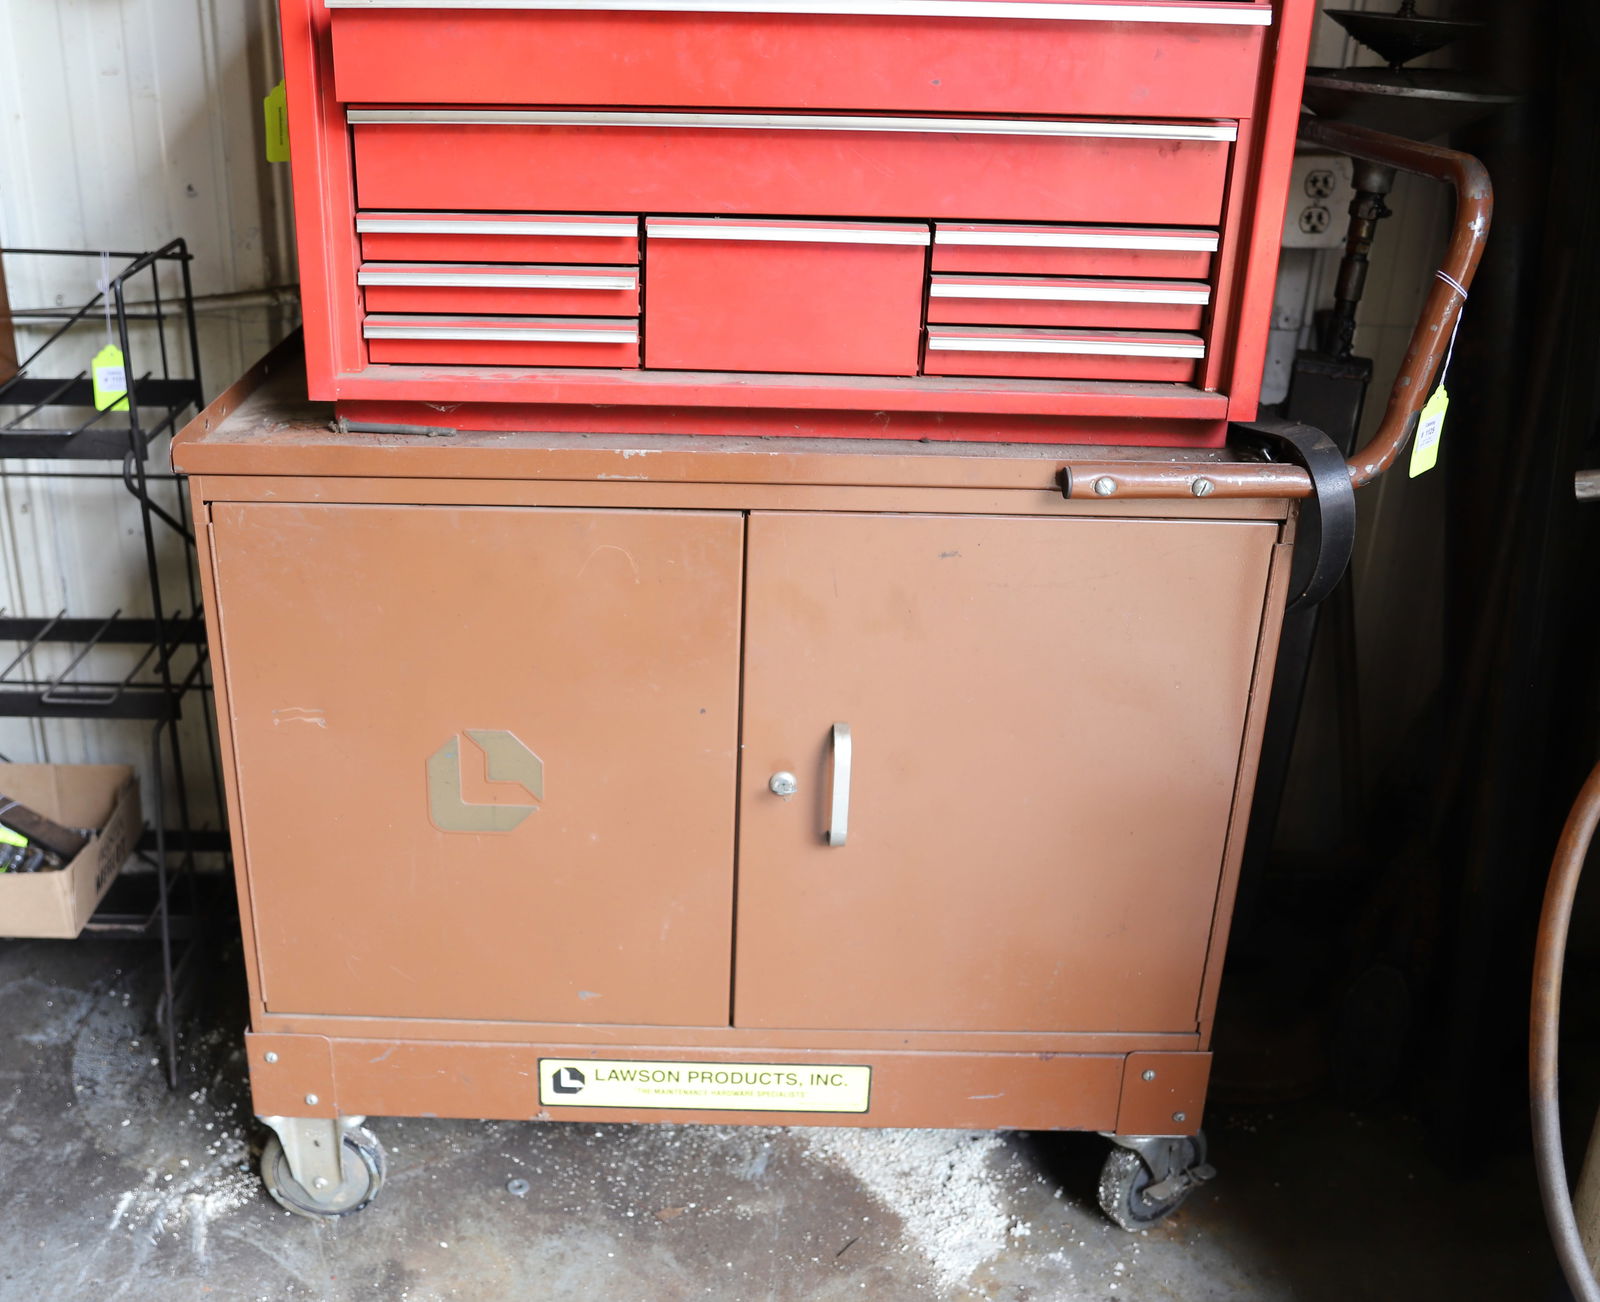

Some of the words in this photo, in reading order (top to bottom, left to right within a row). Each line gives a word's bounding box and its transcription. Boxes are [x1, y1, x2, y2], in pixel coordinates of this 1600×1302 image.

[594, 1068, 680, 1084] LAWSON
[687, 1070, 804, 1087] PRODUCTS,
[810, 1073, 848, 1087] INC.
[654, 1088, 708, 1096] MAINTENANCE
[710, 1089, 753, 1097] HARDWARE
